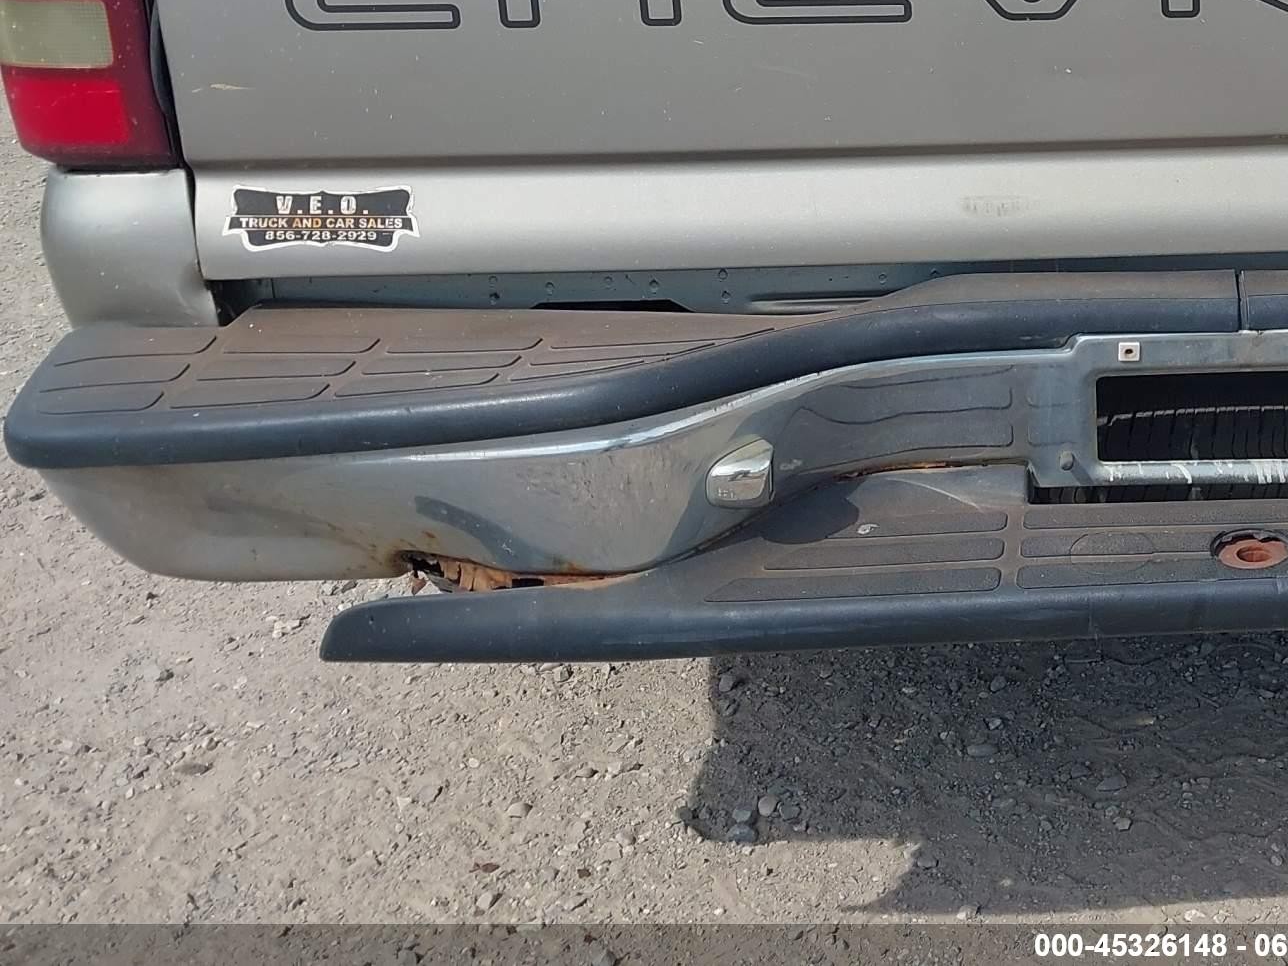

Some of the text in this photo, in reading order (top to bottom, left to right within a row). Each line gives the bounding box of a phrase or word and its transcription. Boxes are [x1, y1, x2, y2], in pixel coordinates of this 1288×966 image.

[239, 217, 403, 228] TRUCK AND CAR SALES
[265, 230, 377, 241] 856-728-2929
